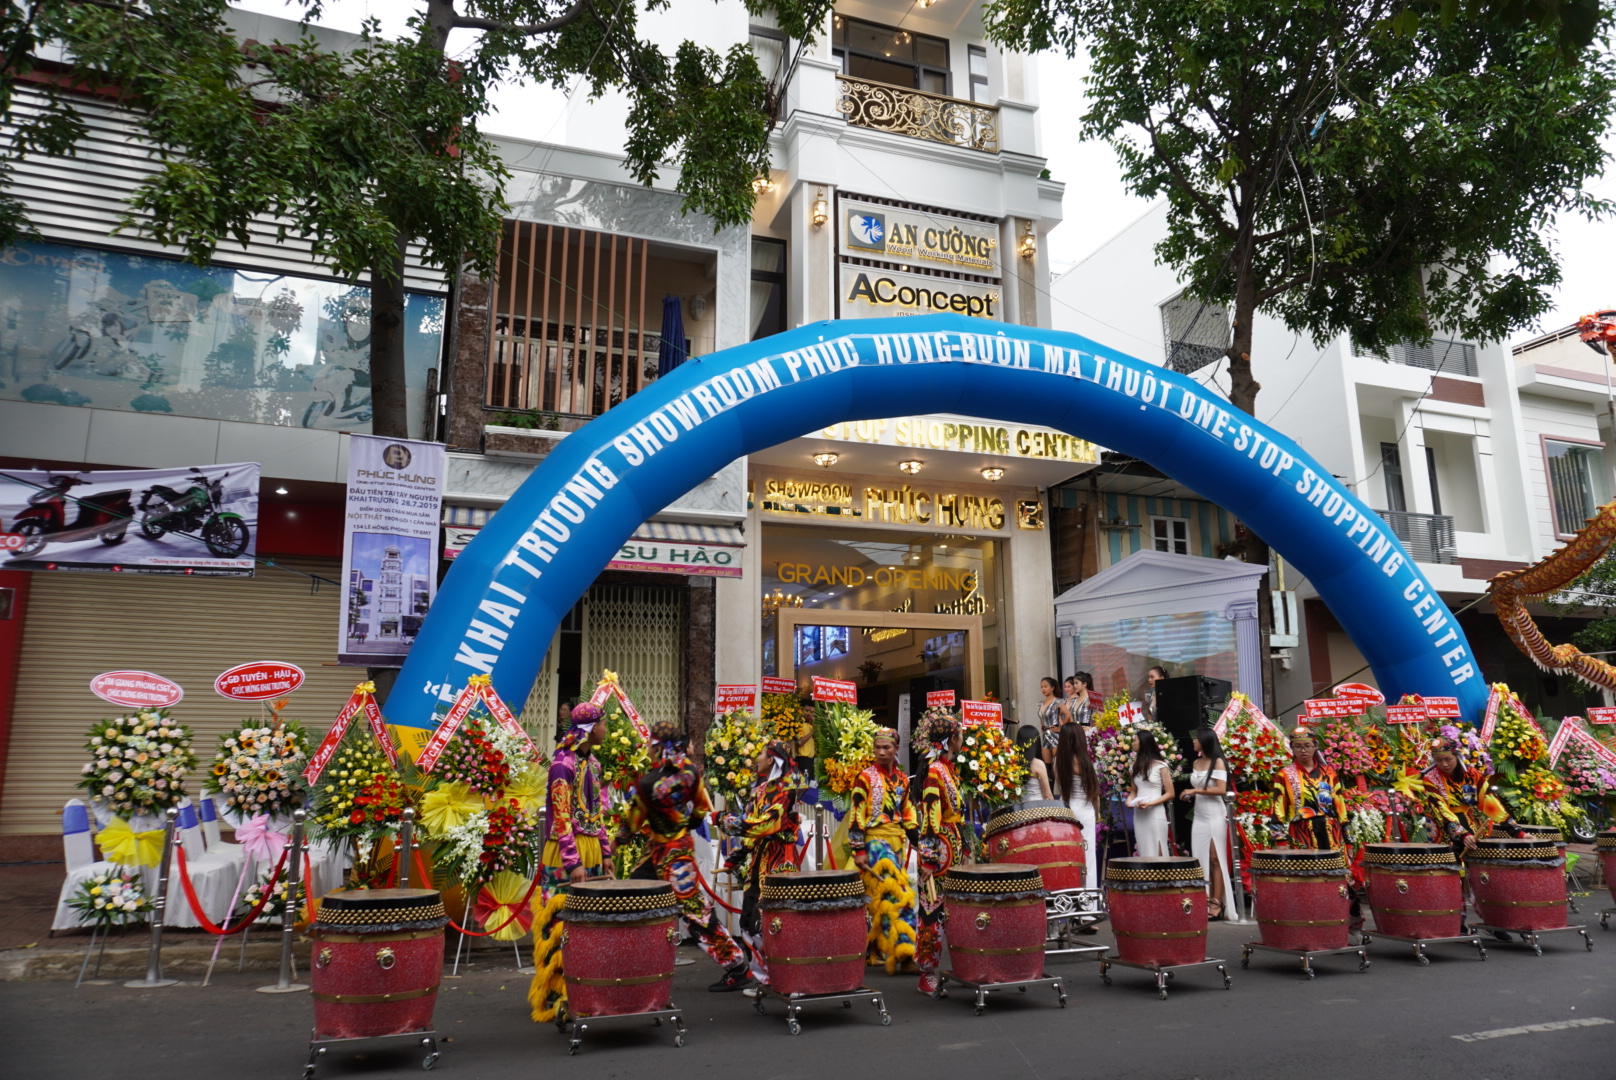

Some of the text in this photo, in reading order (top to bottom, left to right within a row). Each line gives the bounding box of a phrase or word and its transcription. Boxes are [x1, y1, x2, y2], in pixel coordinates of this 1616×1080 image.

[889, 222, 990, 259] AN CƯỜNG
[887, 244, 994, 266] Wood Working Materials
[848, 273, 994, 317] AConcept
[895, 418, 1010, 454] SHOPPING
[1016, 430, 1097, 462] CENTER
[357, 469, 395, 480] PHÚC
[386, 482, 413, 490] SHOPPING
[767, 480, 853, 503] SHOWROOM
[401, 500, 438, 510] 28.7.2019
[454, 580, 527, 674] KHAI
[613, 358, 782, 466] SHOWROOM
[781, 335, 860, 383] PHÚC
[1043, 347, 1081, 379] MA
[1093, 354, 1173, 411] THUỘT
[1179, 391, 1294, 477] ONE-STOP
[1295, 468, 1404, 578] SHOPPING
[1403, 578, 1475, 686] CENTER
[864, 486, 1005, 531] PHÚC HƯNG
[620, 545, 732, 565] SU HÀO
[778, 562, 977, 592] GRAND OPENING
